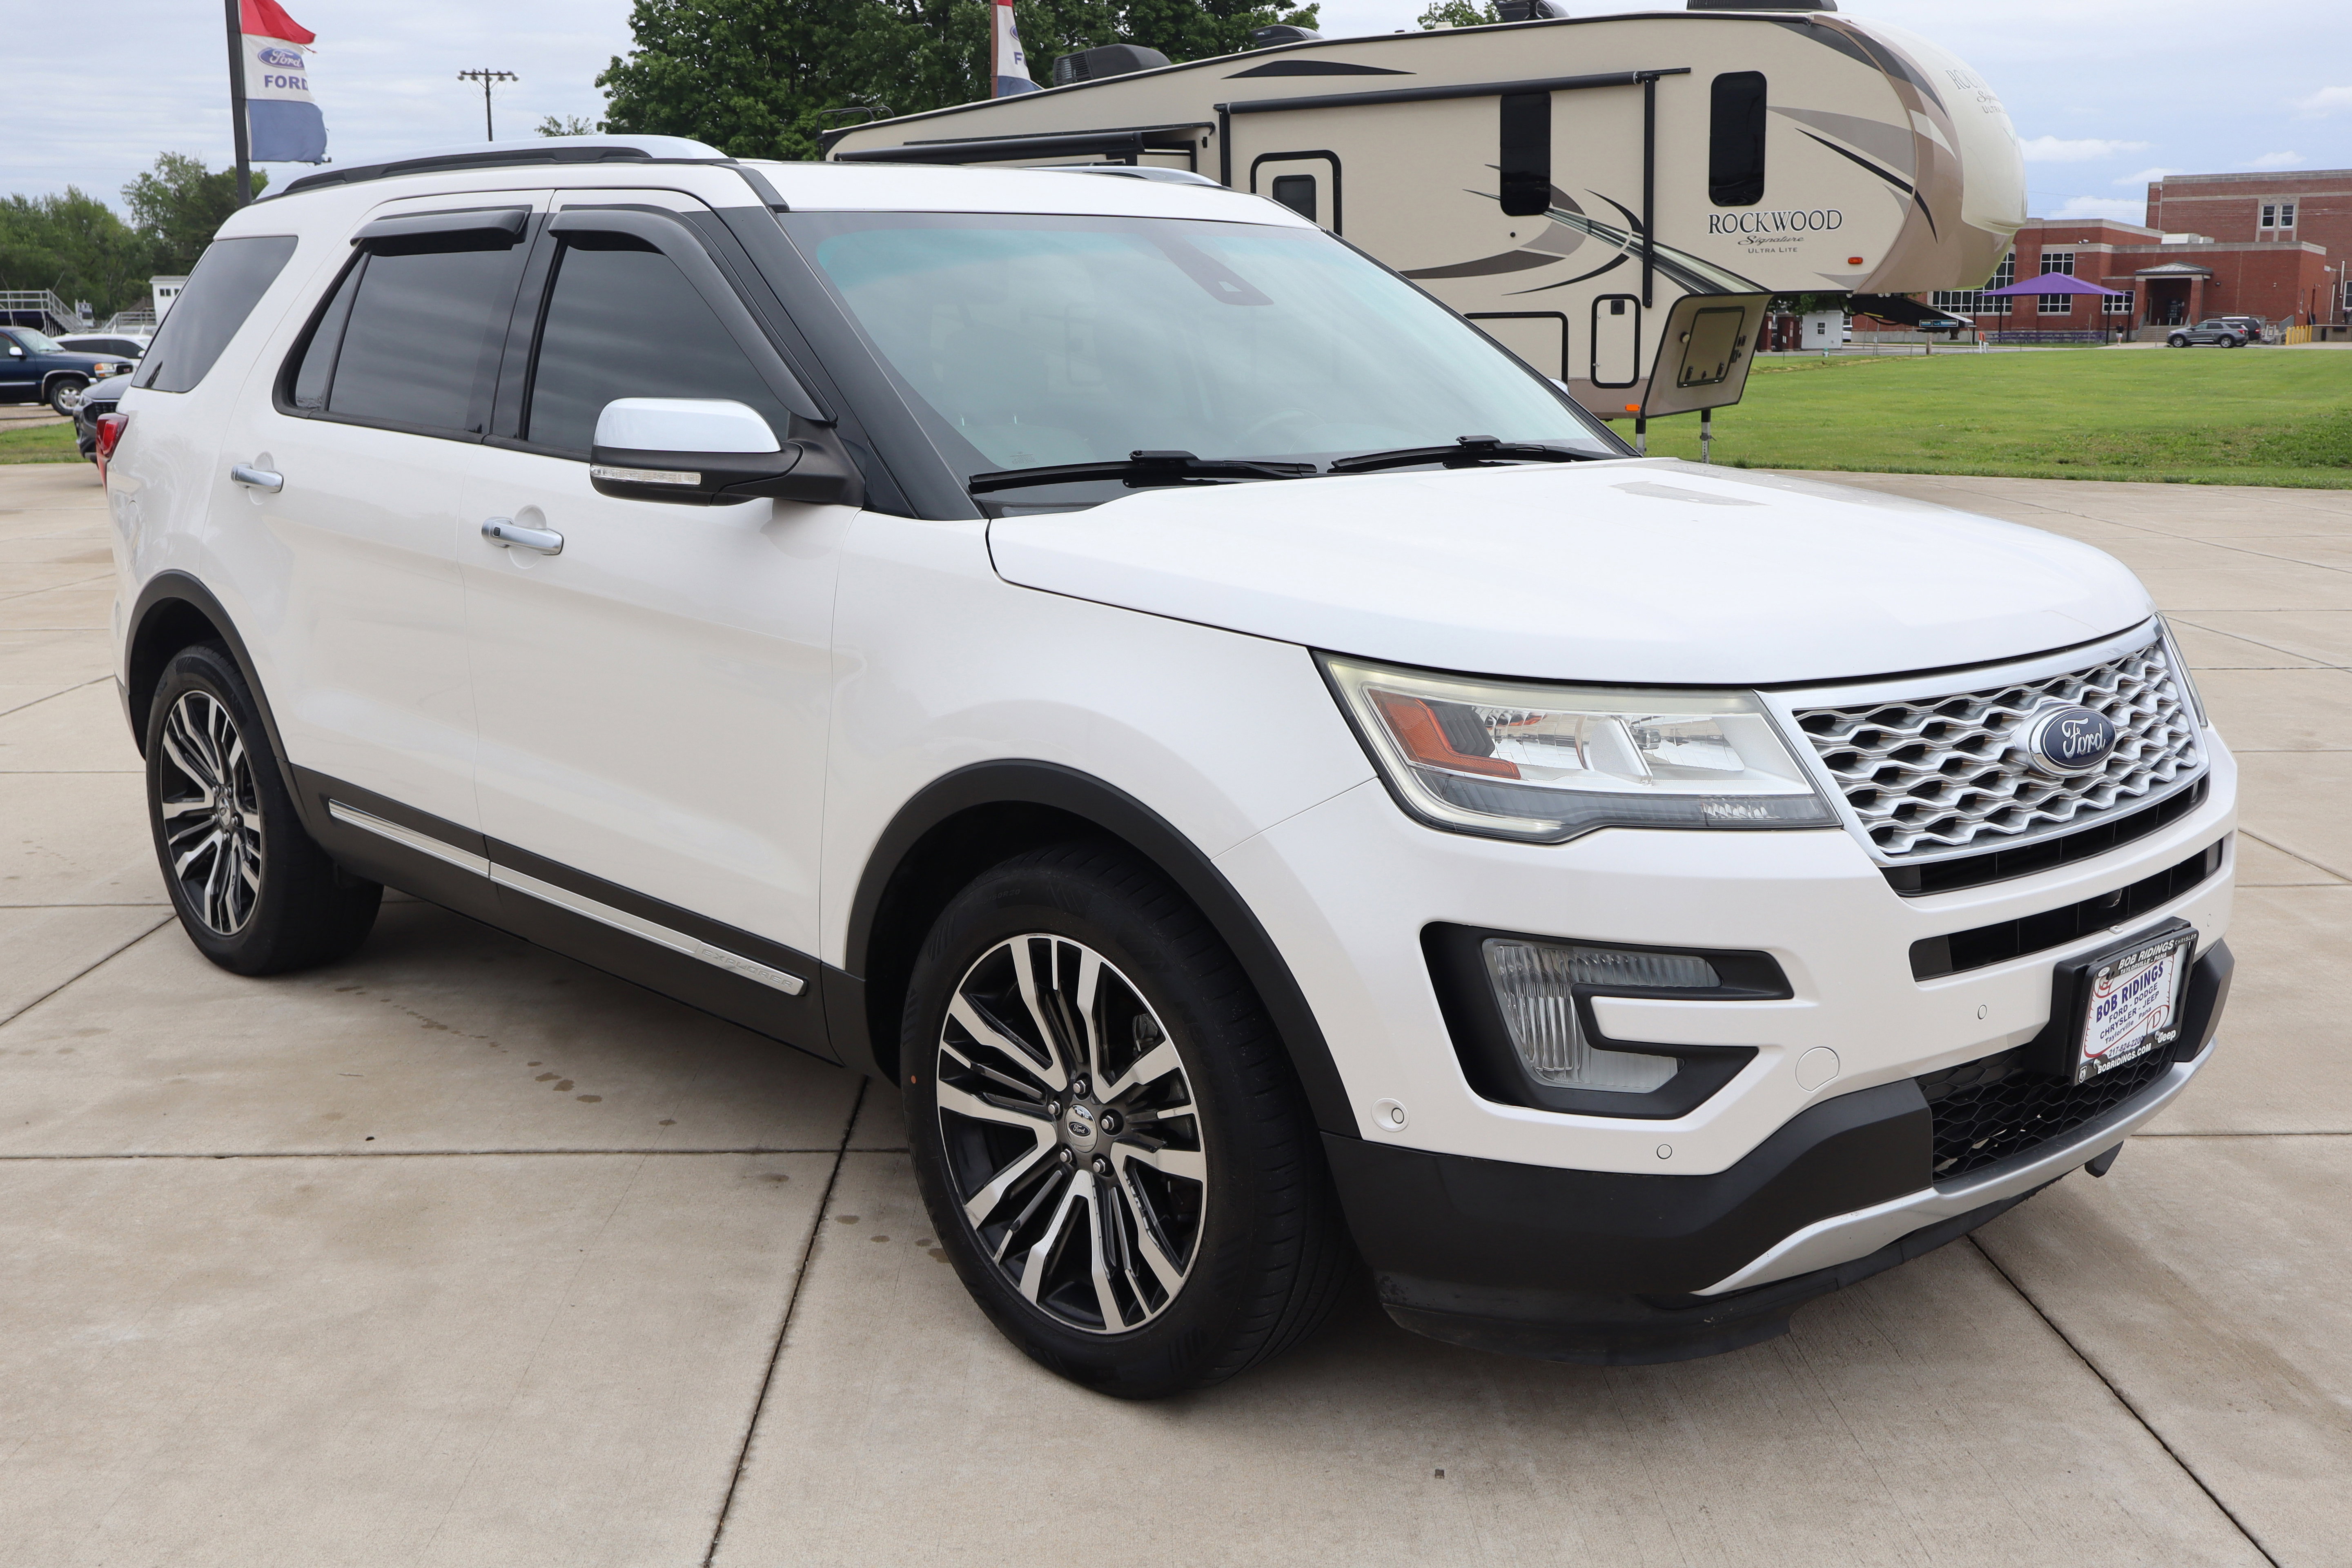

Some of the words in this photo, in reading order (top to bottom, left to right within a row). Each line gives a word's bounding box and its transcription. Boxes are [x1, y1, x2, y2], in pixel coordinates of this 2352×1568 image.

[270, 48, 302, 67] Ford
[264, 75, 308, 91] FORD
[1708, 209, 1842, 234] ROCKWOOD
[1737, 235, 1805, 246] Signature
[2061, 717, 2106, 759] Ford
[2118, 953, 2137, 970] BOB
[2138, 939, 2174, 961] RIDINGS
[2120, 958, 2150, 975] TAYLORVILLE
[2154, 953, 2167, 962] PANA
[702, 949, 794, 989] EXPLORER
[2096, 994, 2118, 1023] BOB
[2121, 960, 2164, 1004] RIDINGS
[2109, 1004, 2128, 1024] FORD
[2134, 982, 2158, 1005] DODGE
[2100, 1007, 2137, 1039] CHRYSLER
[2143, 991, 2159, 1008] JEEP
[2105, 1020, 2134, 1044] Taylorville
[2138, 1007, 2152, 1020] Pana
[2108, 1035, 2144, 1057] 217-824-2200
[2157, 1029, 2176, 1043] Jeep
[2097, 1042, 2152, 1075] BOBRIDINGS.COM
[1073, 1124, 1085, 1134] Ford
